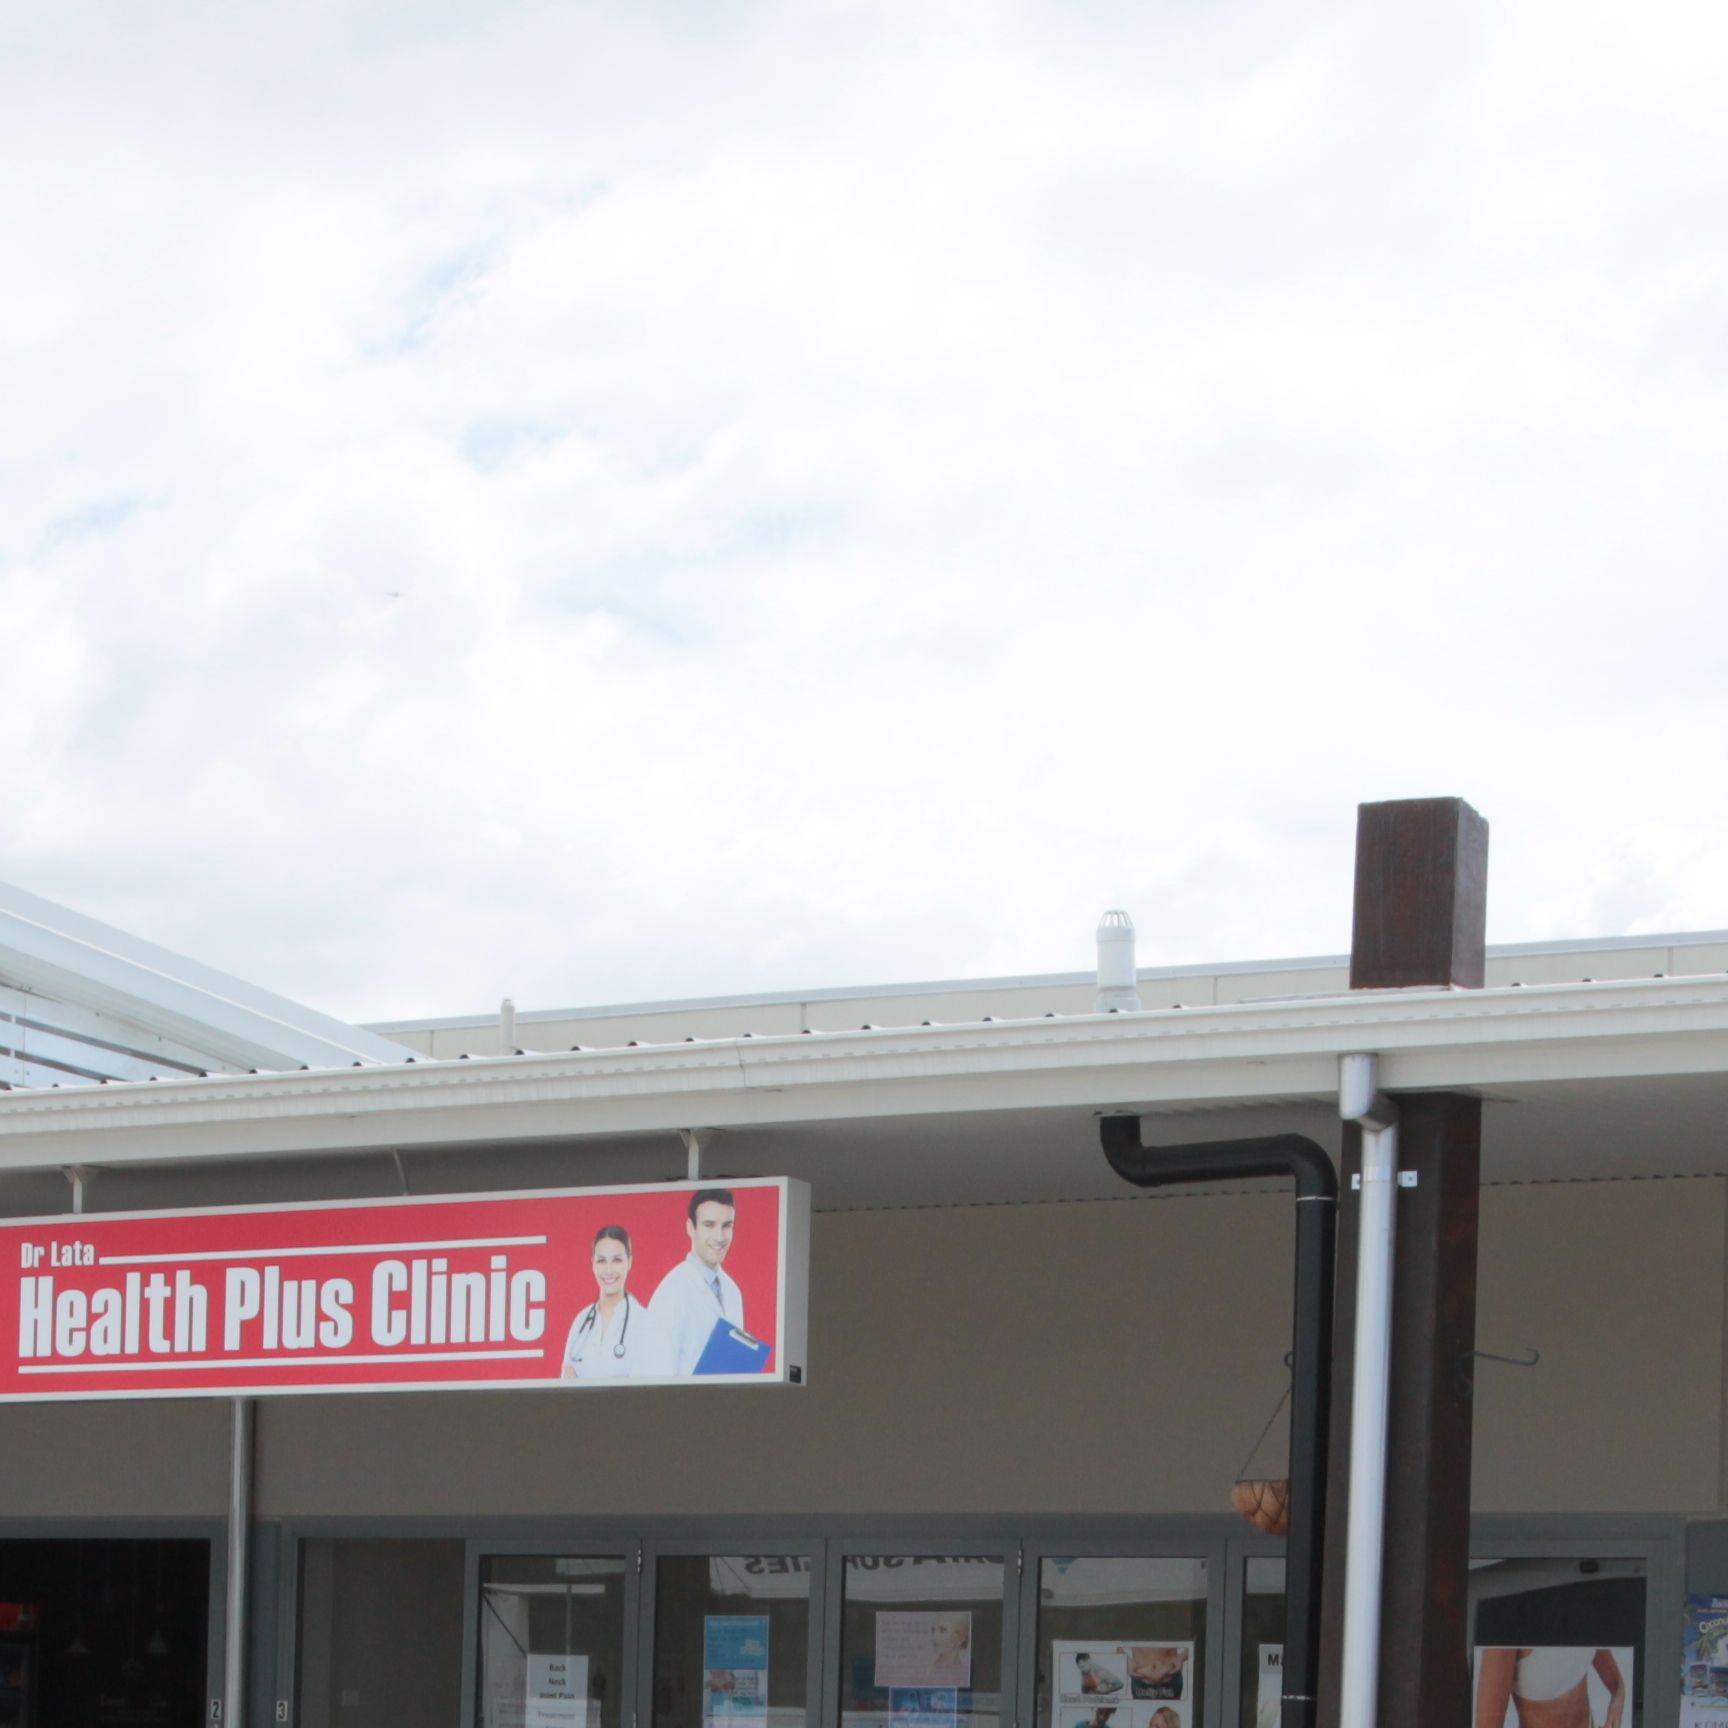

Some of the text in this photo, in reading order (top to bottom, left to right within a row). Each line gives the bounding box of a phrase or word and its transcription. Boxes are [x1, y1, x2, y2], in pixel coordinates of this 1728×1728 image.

[21, 1239, 94, 1269] Dr Lata
[18, 1254, 546, 1358] Health Plus Clinic
[212, 1702, 219, 1718] 2
